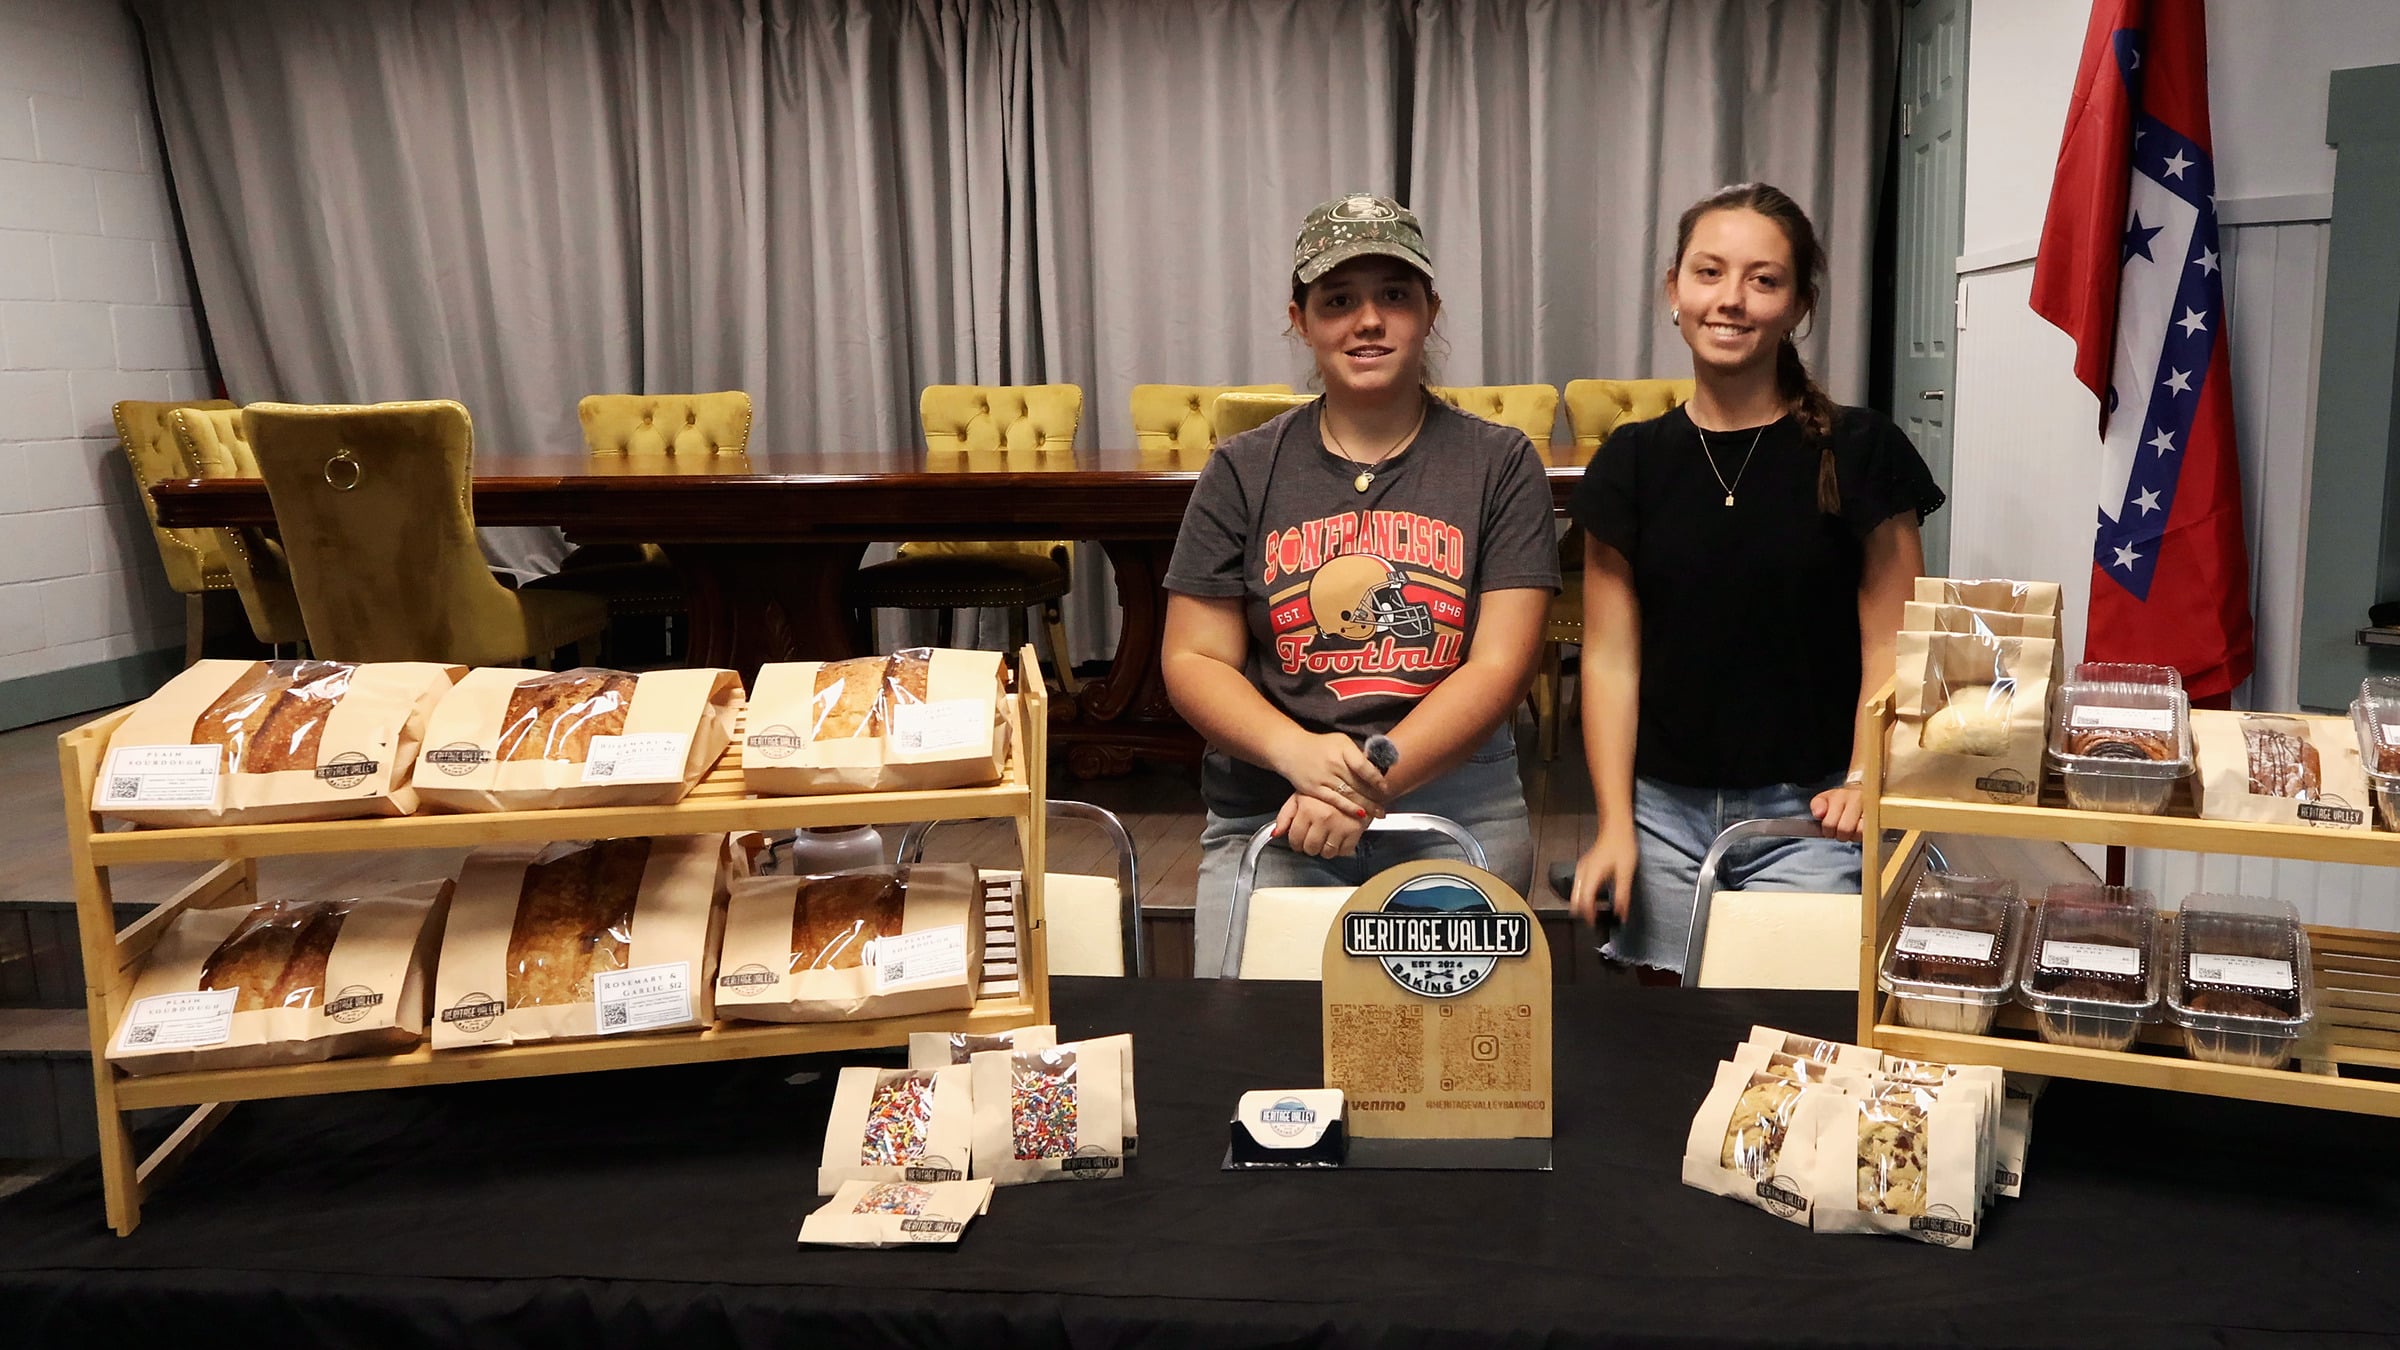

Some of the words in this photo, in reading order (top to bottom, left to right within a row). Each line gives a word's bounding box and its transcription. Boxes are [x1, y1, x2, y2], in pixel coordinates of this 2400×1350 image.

[1324, 510, 1464, 580] FRANCISCO
[1276, 607, 1305, 625] EST.
[1433, 600, 1462, 617] 1946
[1276, 633, 1462, 675] Football
[2300, 806, 2331, 820] HERITAGE
[2333, 809, 2360, 823] VALLEY
[1353, 918, 1443, 951] HERITAGE
[1447, 918, 1521, 951] VALLEY
[1411, 960, 1432, 969] EST
[1437, 960, 1464, 969] 2024
[604, 975, 663, 990] ROSEMARY
[669, 971, 677, 979] &
[1391, 961, 1455, 993] BAKING
[1459, 968, 1480, 986] CO
[622, 984, 664, 997] GARLIC
[669, 981, 682, 990] $12
[1351, 1100, 1406, 1112] venmo
[1291, 1111, 1315, 1122] VALLEY
[902, 1220, 933, 1232] HERITAGE
[934, 1221, 961, 1233] VALLEY
[1943, 1220, 1970, 1236] VALLEY
